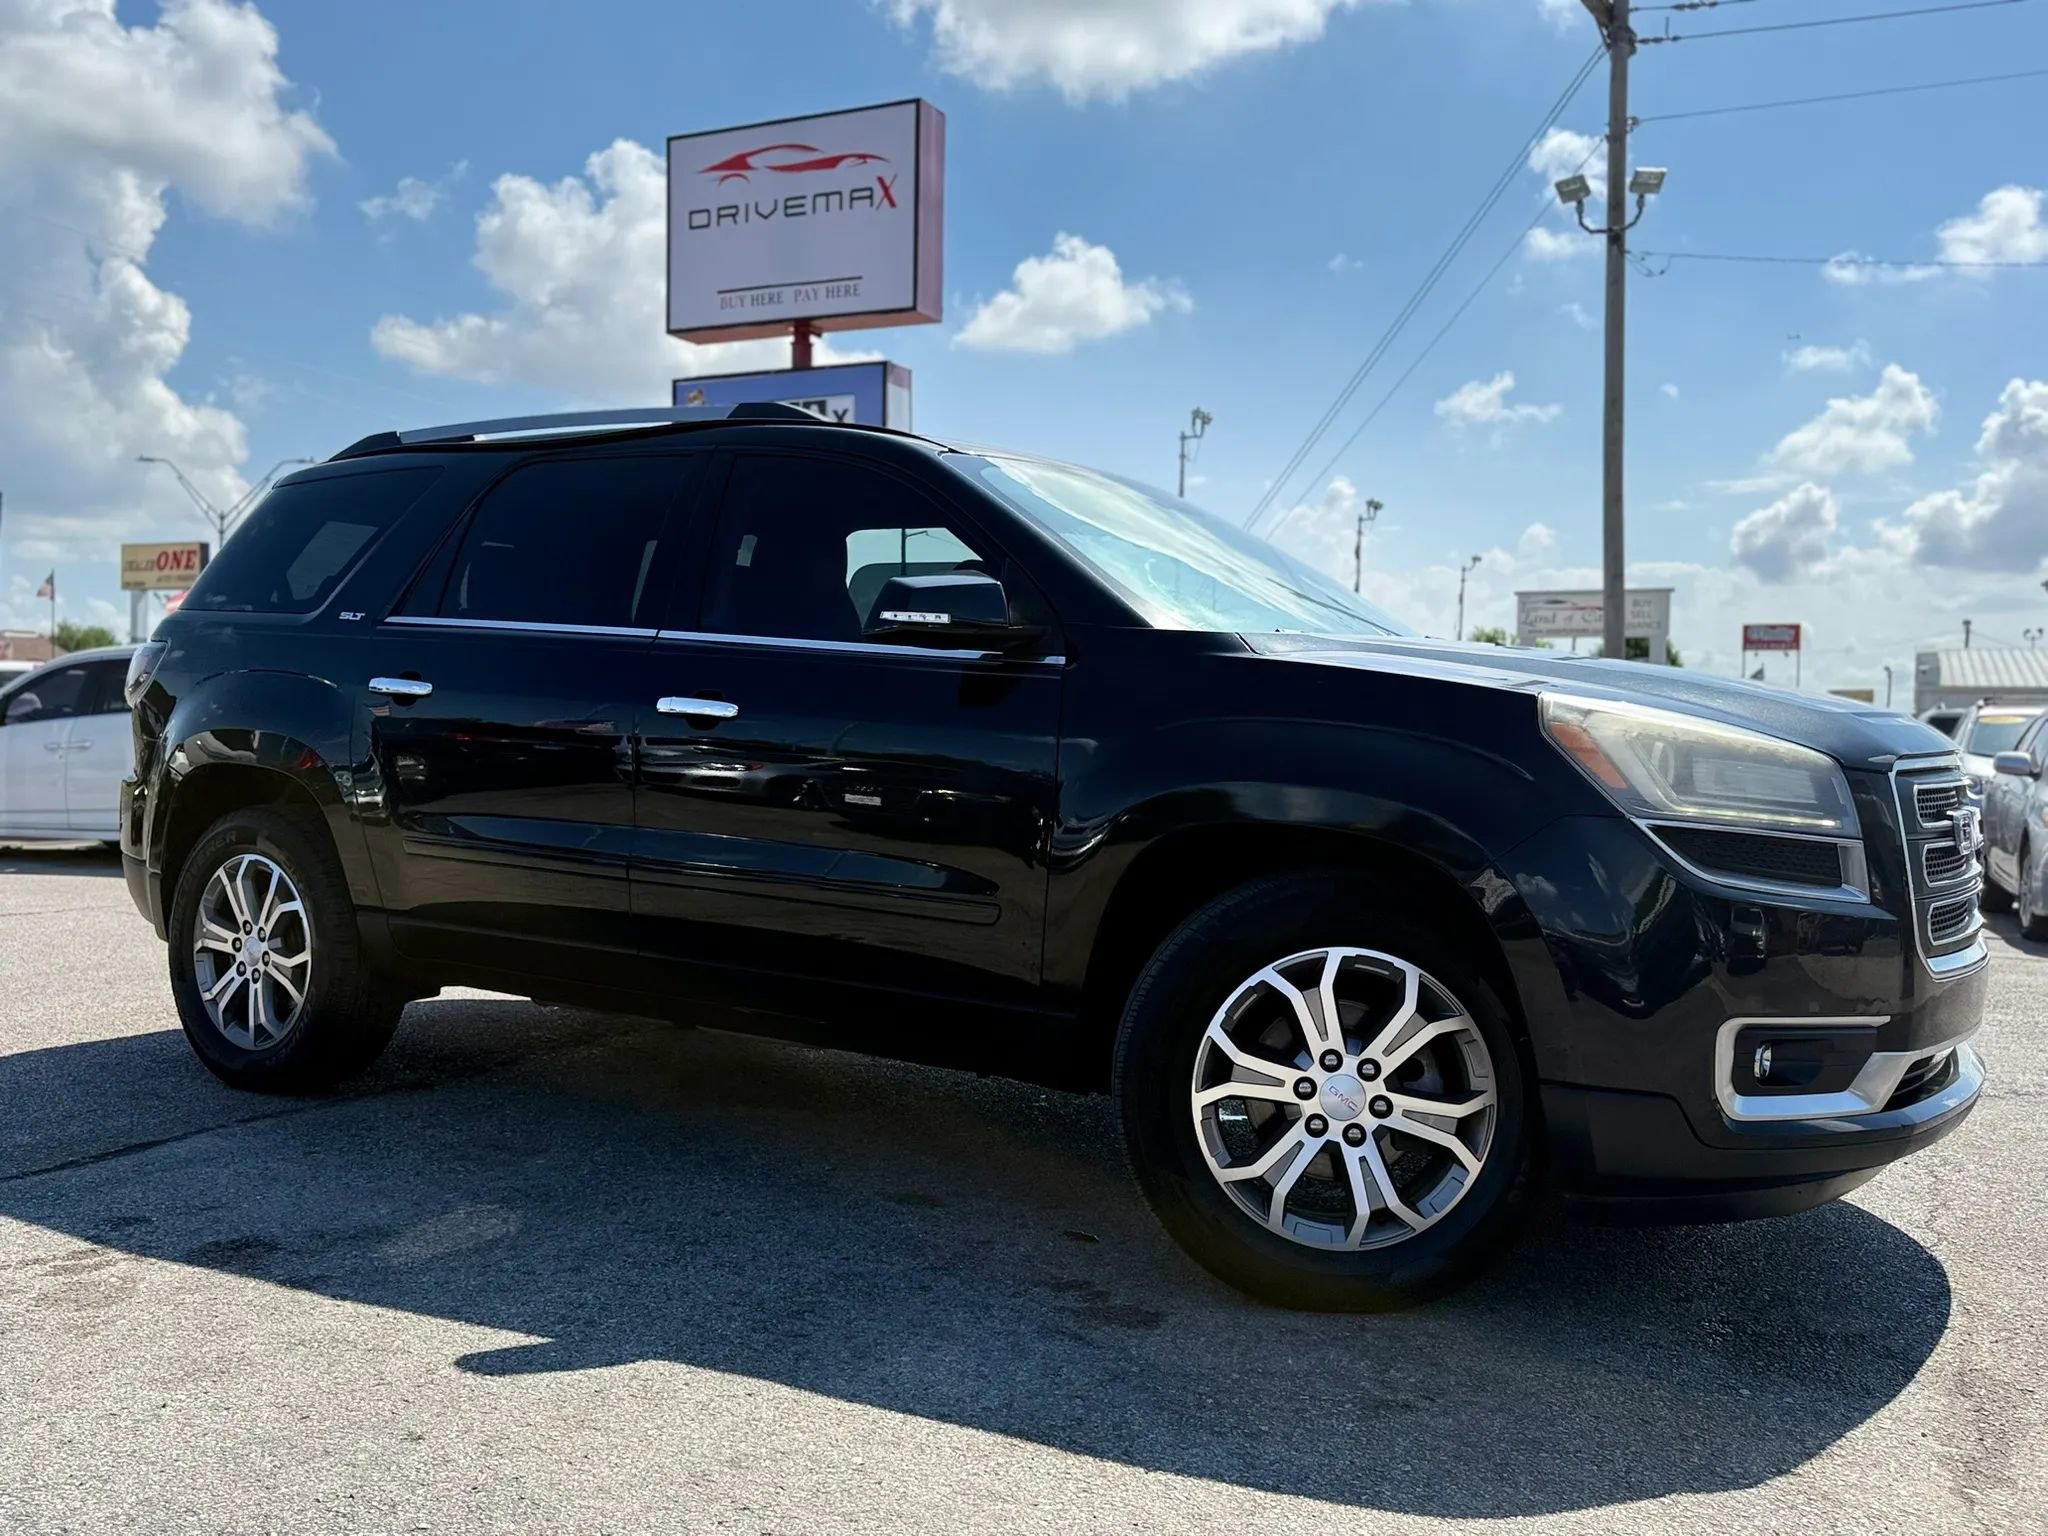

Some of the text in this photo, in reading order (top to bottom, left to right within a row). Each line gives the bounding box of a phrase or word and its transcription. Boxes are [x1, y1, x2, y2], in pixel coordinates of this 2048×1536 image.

[719, 283, 861, 311] BUY HERE PAY HERE
[338, 611, 366, 621] SLT
[1328, 1085, 1358, 1112] GMC
